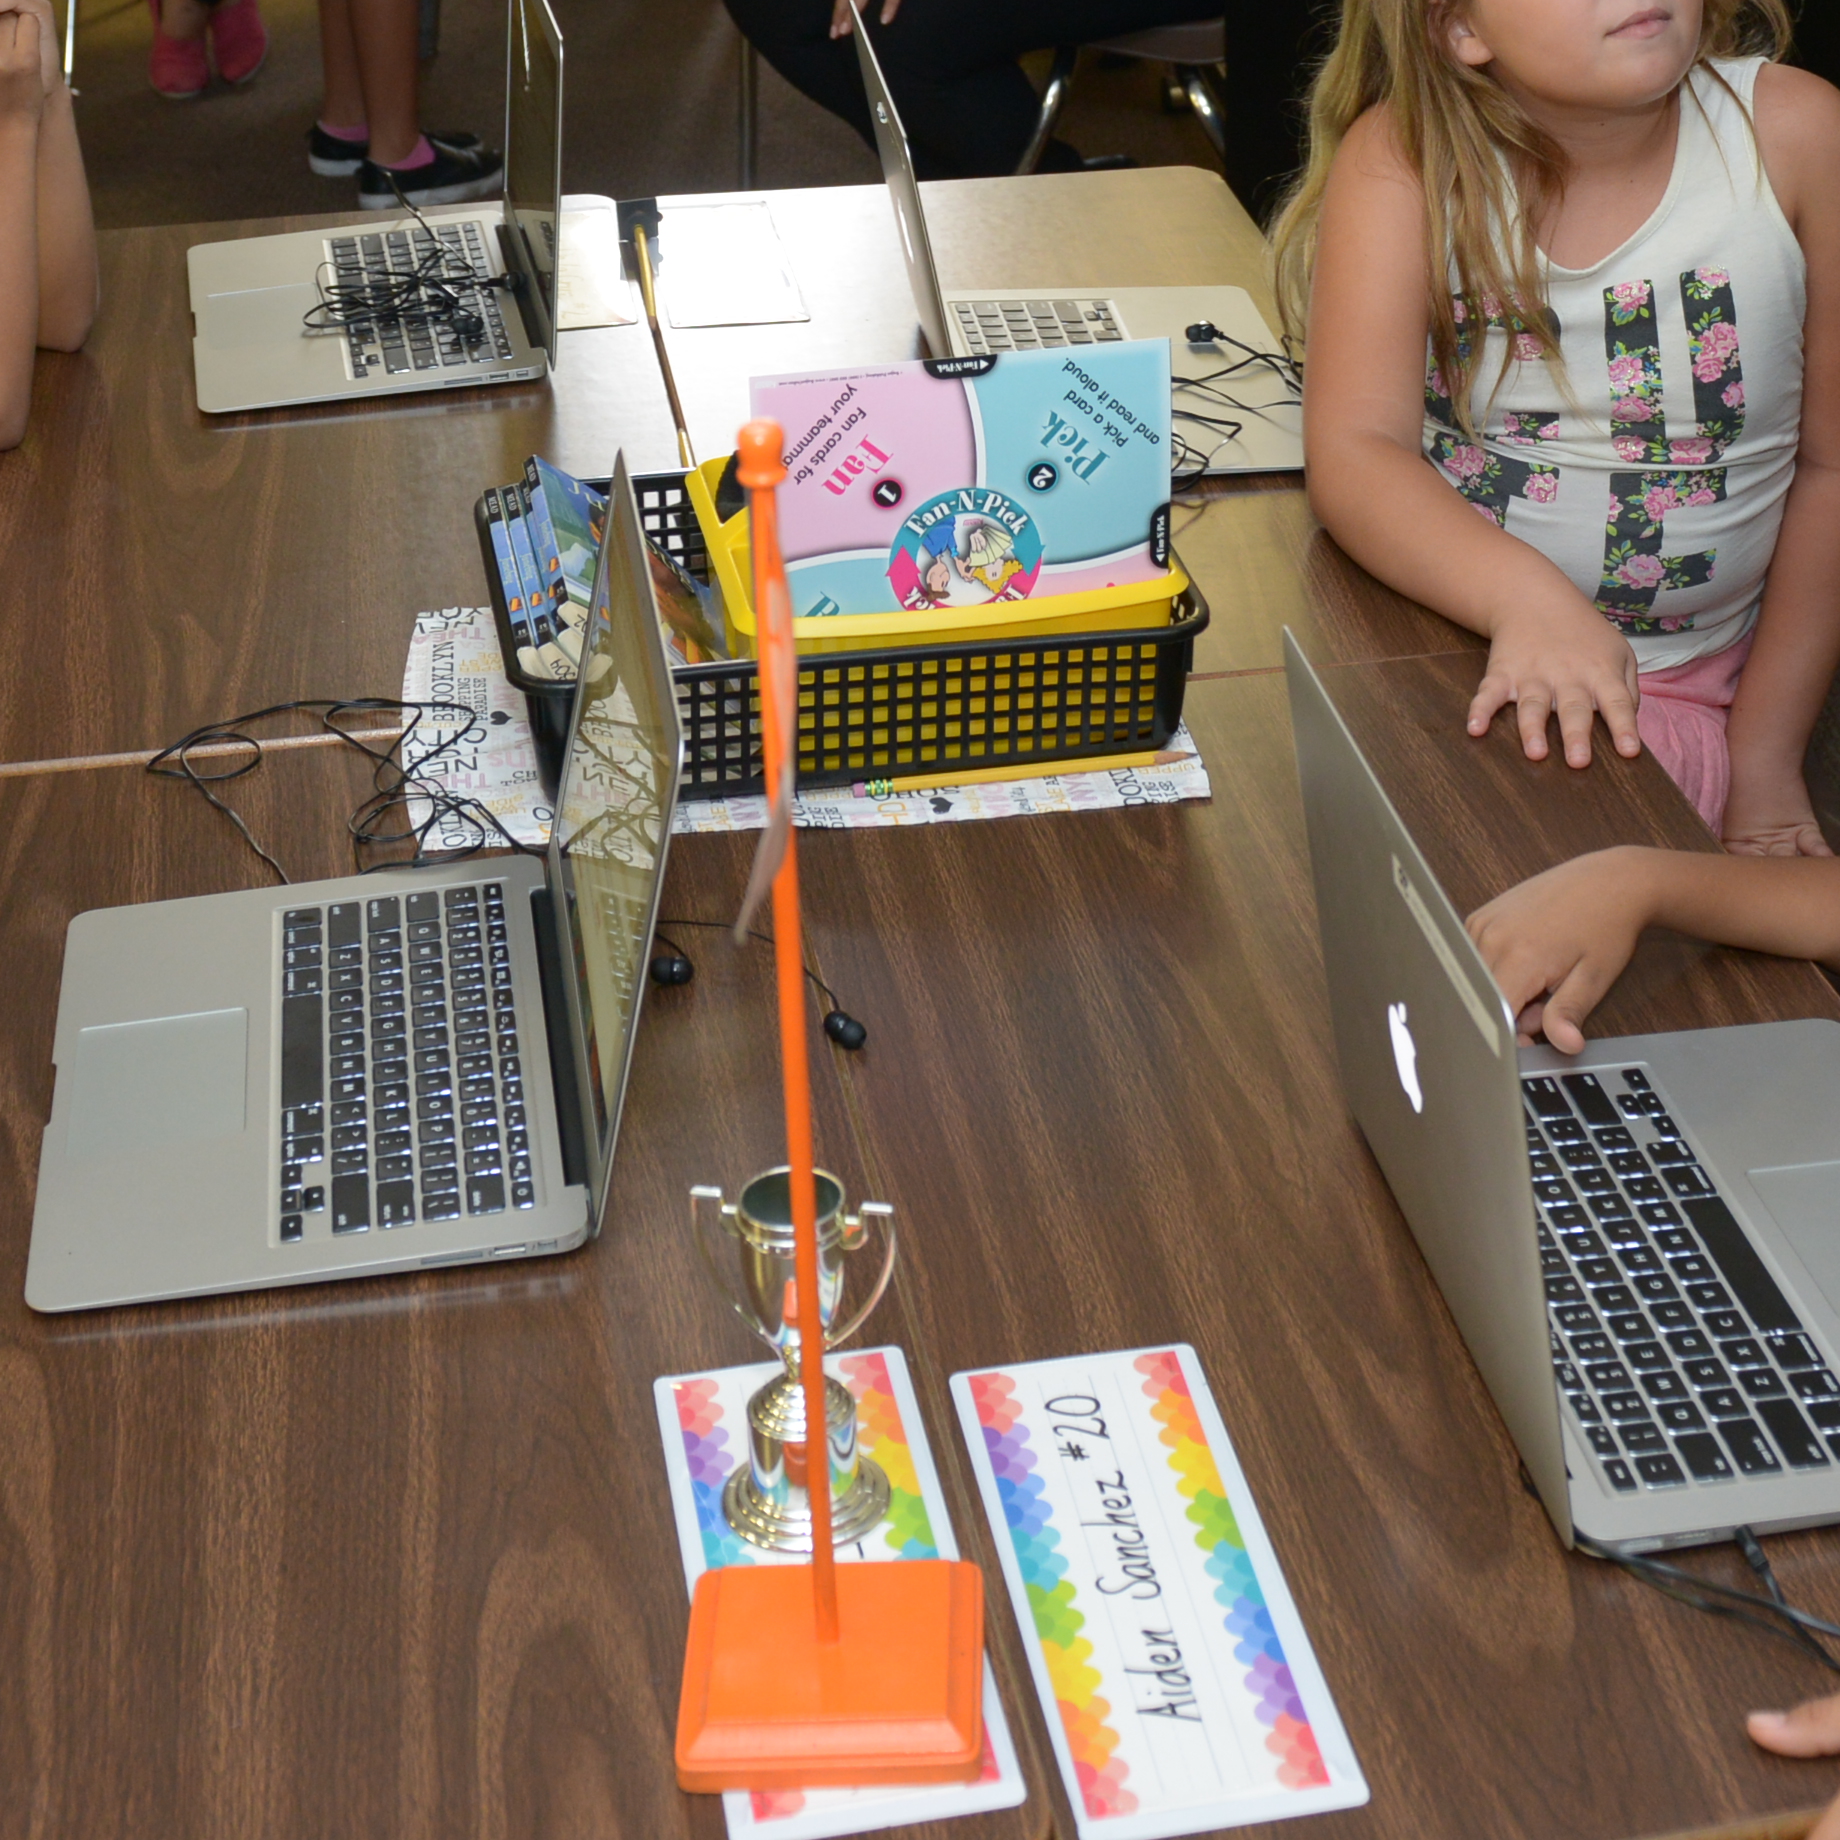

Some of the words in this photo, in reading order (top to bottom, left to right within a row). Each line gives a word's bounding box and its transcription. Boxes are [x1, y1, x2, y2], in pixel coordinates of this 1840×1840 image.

[1062, 357, 1099, 392] aloud.
[831, 383, 858, 416] your
[1063, 389, 1094, 415] card
[1097, 390, 1110, 404] it
[1105, 399, 1137, 425] read
[841, 407, 867, 432] Fan
[1093, 413, 1104, 424] a
[1103, 421, 1129, 448] Pick
[1133, 422, 1160, 445] and
[782, 414, 833, 470] teamma
[810, 432, 842, 466] cards
[1039, 409, 1112, 487] Pick
[793, 464, 814, 485] for
[821, 434, 894, 496] Fan
[1032, 467, 1053, 488] 2
[878, 485, 897, 503] 1
[904, 489, 1030, 538] Fan-N-Pick
[432, 640, 455, 722] BROOKLYN
[476, 677, 487, 722] PARADISE
[1044, 1392, 1101, 1464] #20
[1080, 1469, 1161, 1600] Sanchez
[1123, 1624, 1201, 1724] Aiden
